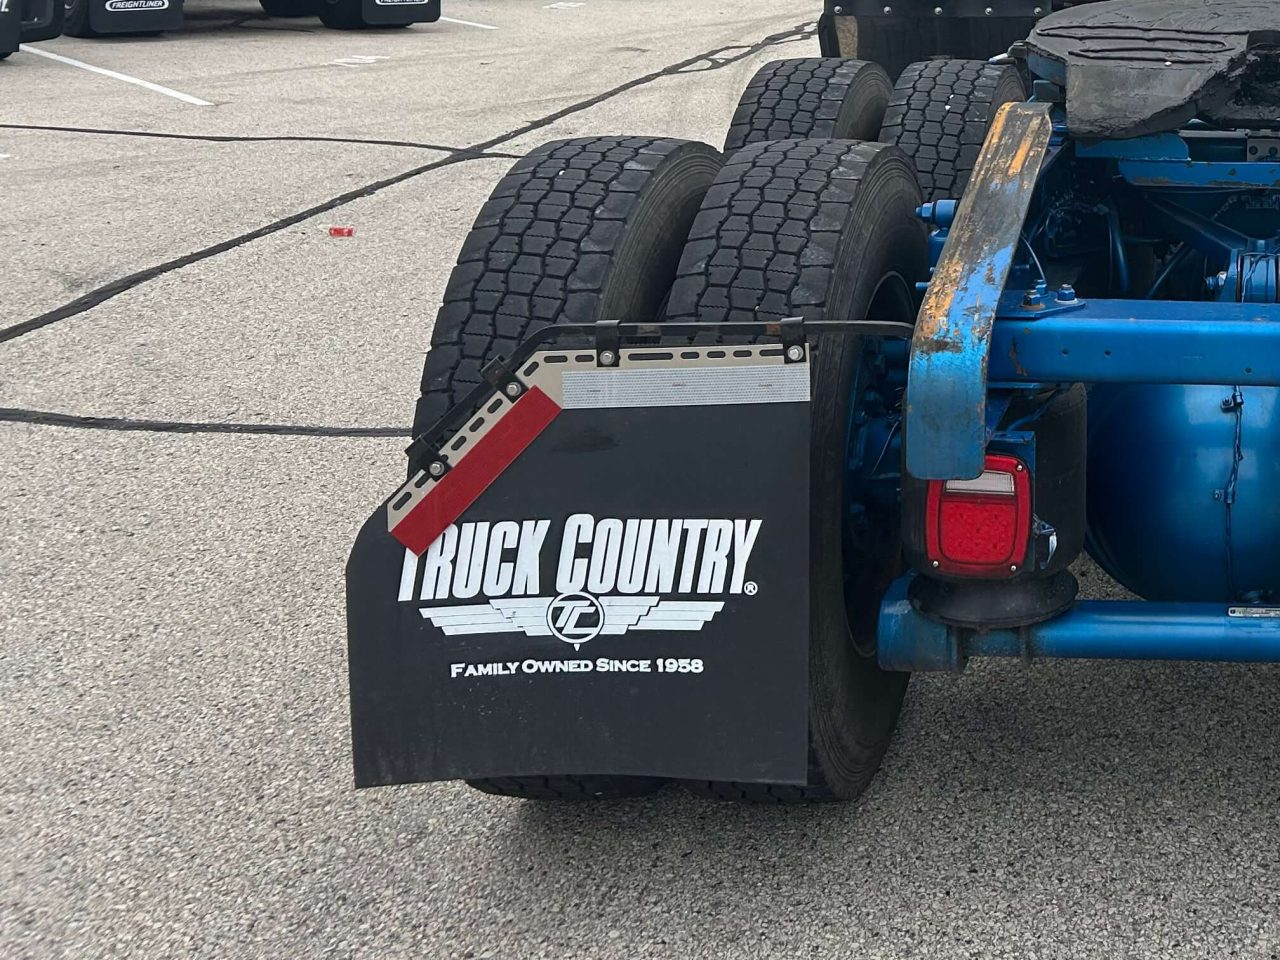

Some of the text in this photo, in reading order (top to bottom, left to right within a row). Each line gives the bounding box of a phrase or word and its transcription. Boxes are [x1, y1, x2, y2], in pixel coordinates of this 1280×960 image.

[111, 0, 163, 9] FREIGHTLINER
[556, 513, 763, 595] COUNTRY
[450, 657, 705, 678] FAMILY OWNED SINCE 1958
